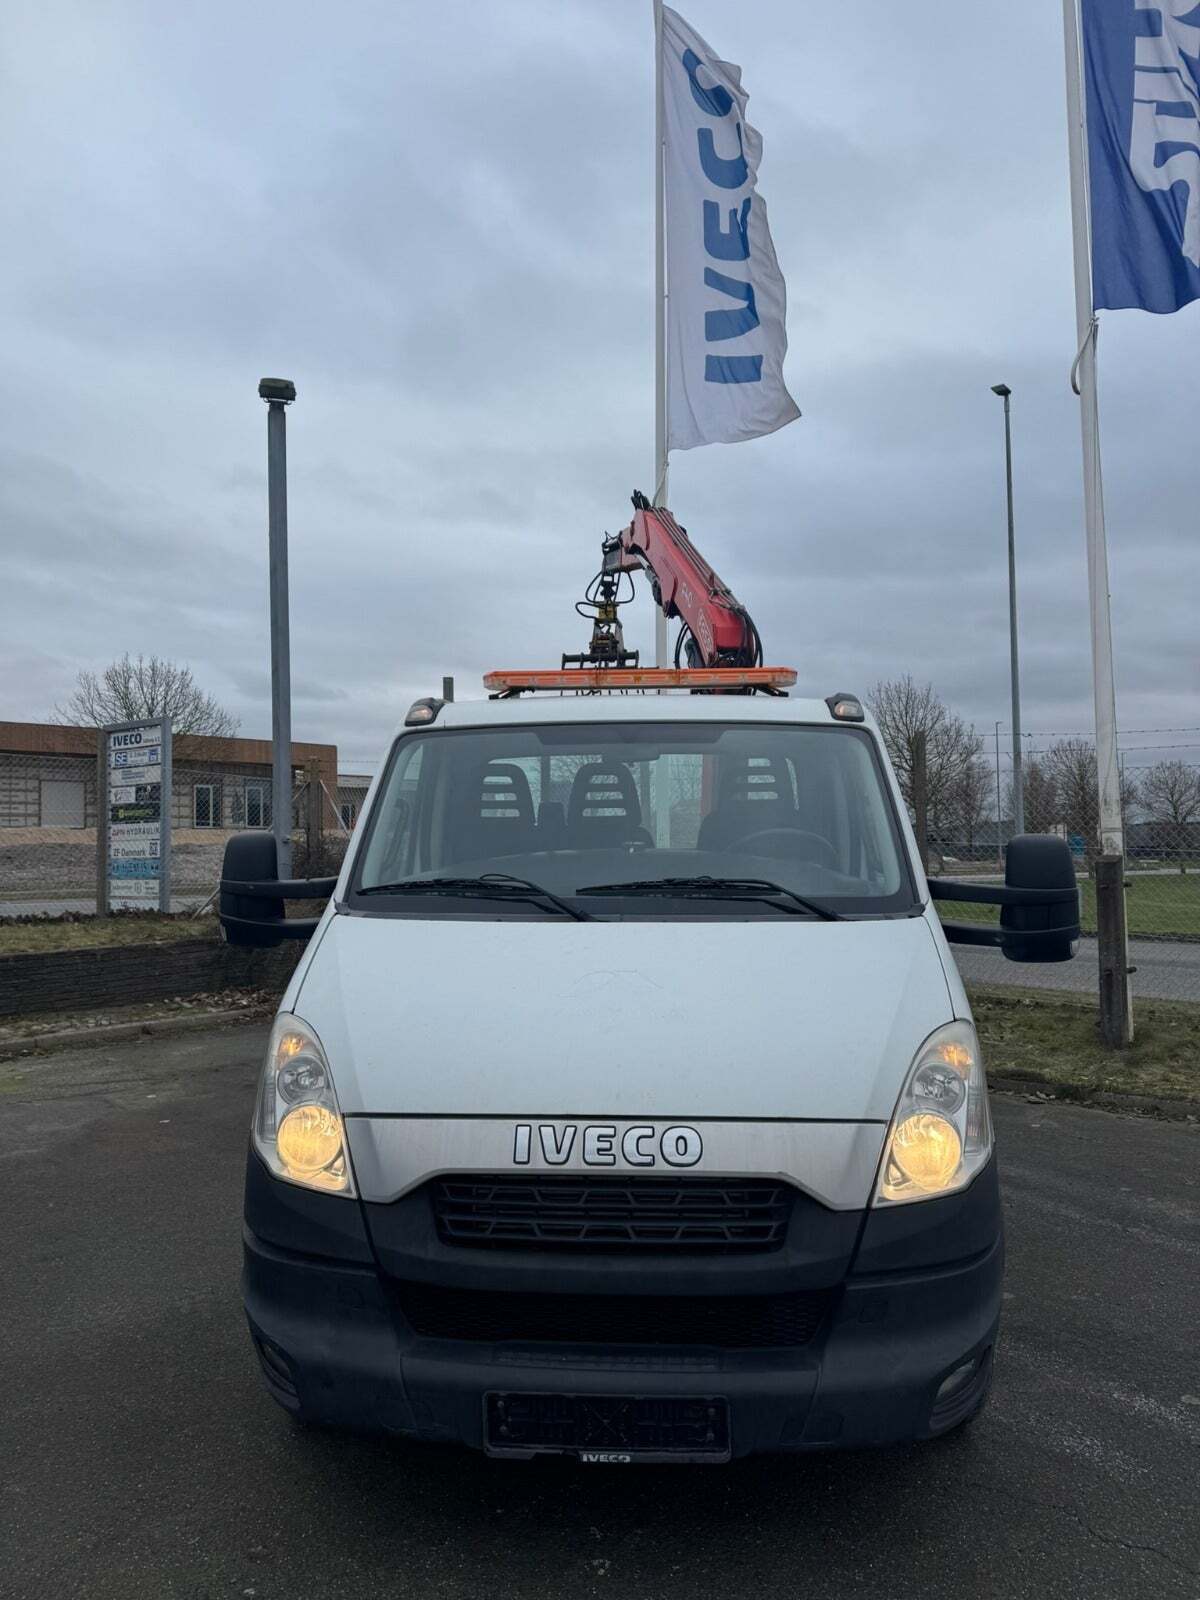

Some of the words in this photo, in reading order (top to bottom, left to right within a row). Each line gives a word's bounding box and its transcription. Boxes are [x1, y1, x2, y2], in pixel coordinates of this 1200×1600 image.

[682, 48, 763, 384] IVECO
[113, 733, 142, 747] IVECO
[121, 848, 146, 857] Danmark
[513, 1124, 703, 1167] IVECO
[582, 1453, 631, 1463] IVECO
